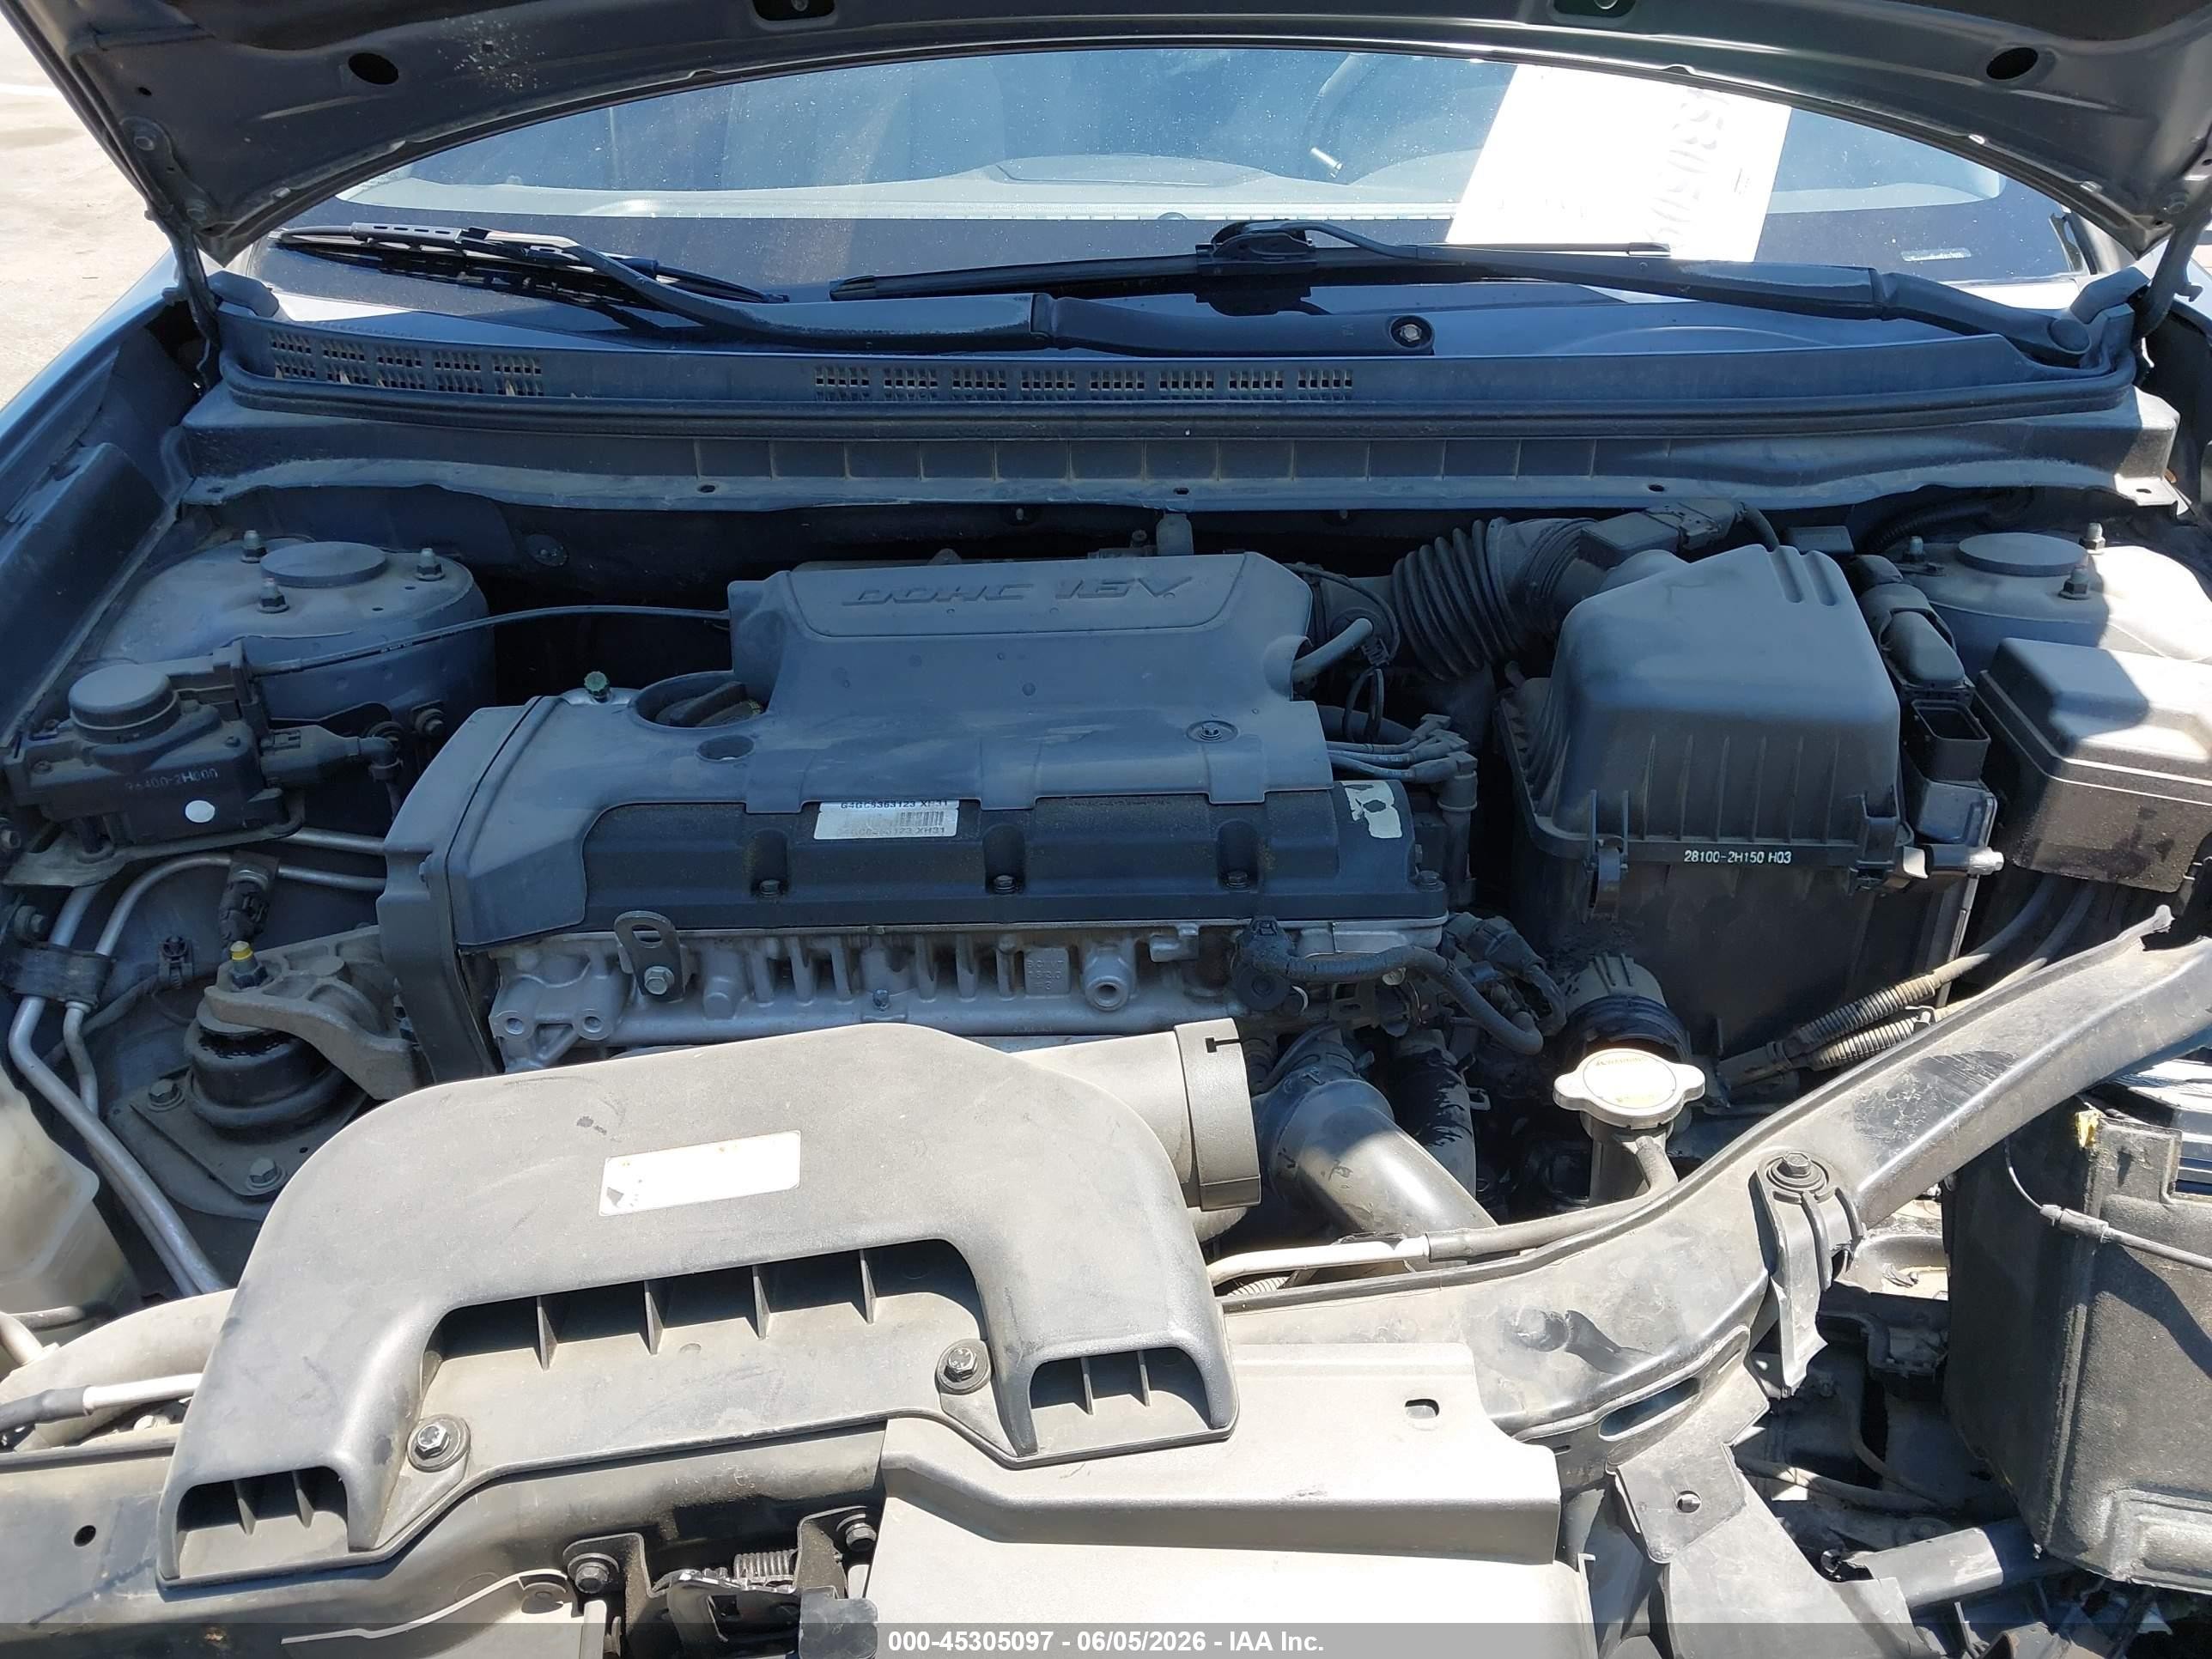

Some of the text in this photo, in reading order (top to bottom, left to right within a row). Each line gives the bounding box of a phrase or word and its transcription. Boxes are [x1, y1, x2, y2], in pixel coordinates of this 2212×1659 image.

[840, 574, 1194, 606] DOHC 16V
[1683, 849, 1792, 865] 28100-2H150 H03
